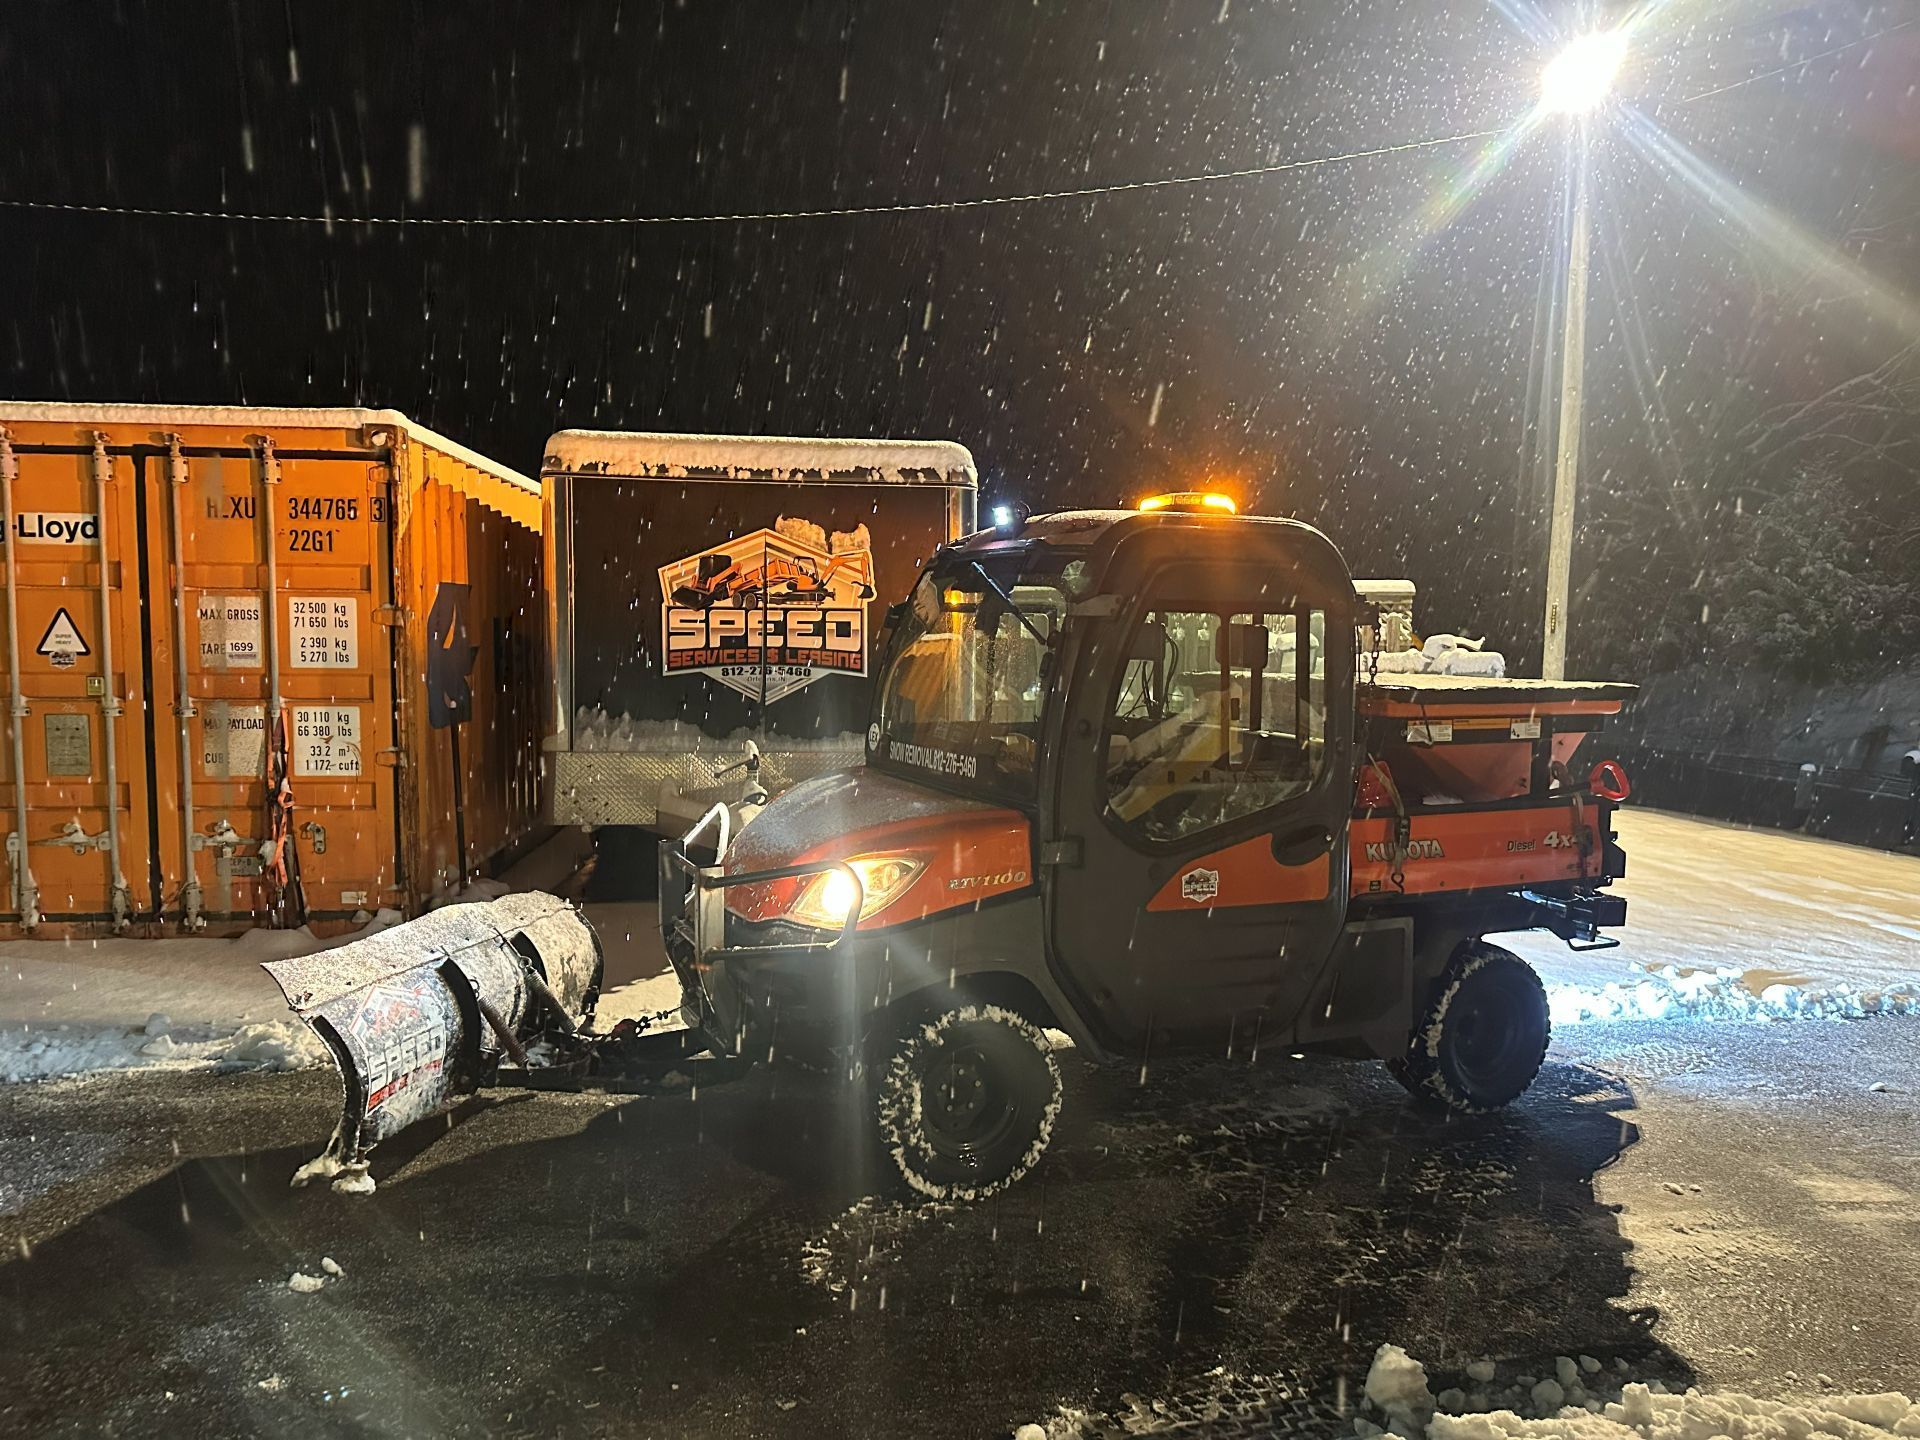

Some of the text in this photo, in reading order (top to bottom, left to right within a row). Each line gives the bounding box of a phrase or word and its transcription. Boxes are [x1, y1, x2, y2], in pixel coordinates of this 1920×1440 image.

[288, 497, 359, 520] 344765
[372, 499, 384, 521] 3
[289, 529, 334, 552] 22G1
[227, 608, 259, 620] GROSS
[293, 602, 346, 616] 32 500 kg
[294, 616, 349, 628] 71 650 lbs
[669, 609, 862, 652] SPEED
[201, 643, 225, 655] TARE
[230, 642, 254, 651] 1699
[300, 637, 347, 651] 2 390 kg
[300, 651, 350, 663] 5 270 lbs
[668, 648, 760, 667] SERVICES
[786, 650, 862, 668] LEASING
[297, 711, 350, 725] 30 110 kg
[297, 726, 352, 737] 66 380 lbs
[889, 741, 906, 761] SNOW
[905, 743, 933, 769] REMOVAL
[315, 759, 331, 771] 172
[1507, 840, 1537, 853] Diesel
